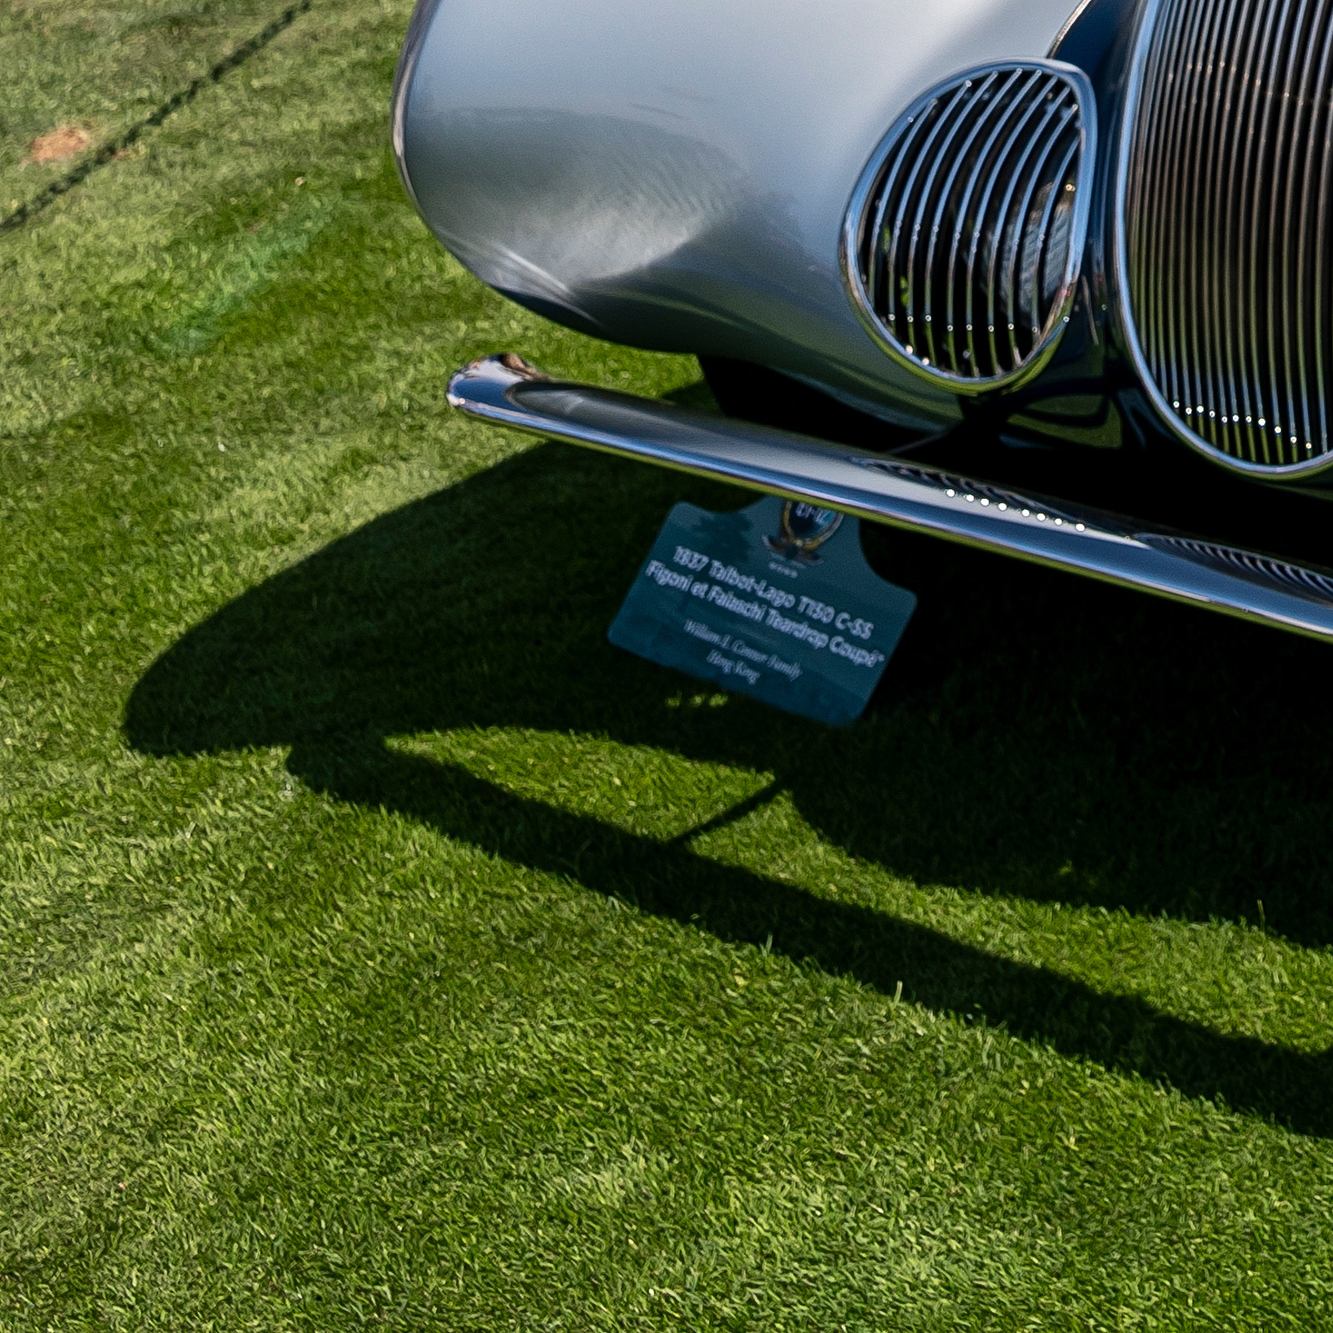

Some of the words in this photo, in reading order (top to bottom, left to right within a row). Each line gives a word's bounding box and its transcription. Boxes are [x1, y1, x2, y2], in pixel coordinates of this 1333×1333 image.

[645, 560, 694, 591] Figoni
[691, 581, 709, 599] et
[766, 608, 829, 649] Teardrop
[709, 559, 796, 608] Talbot-Lago
[835, 612, 875, 640] C-SS
